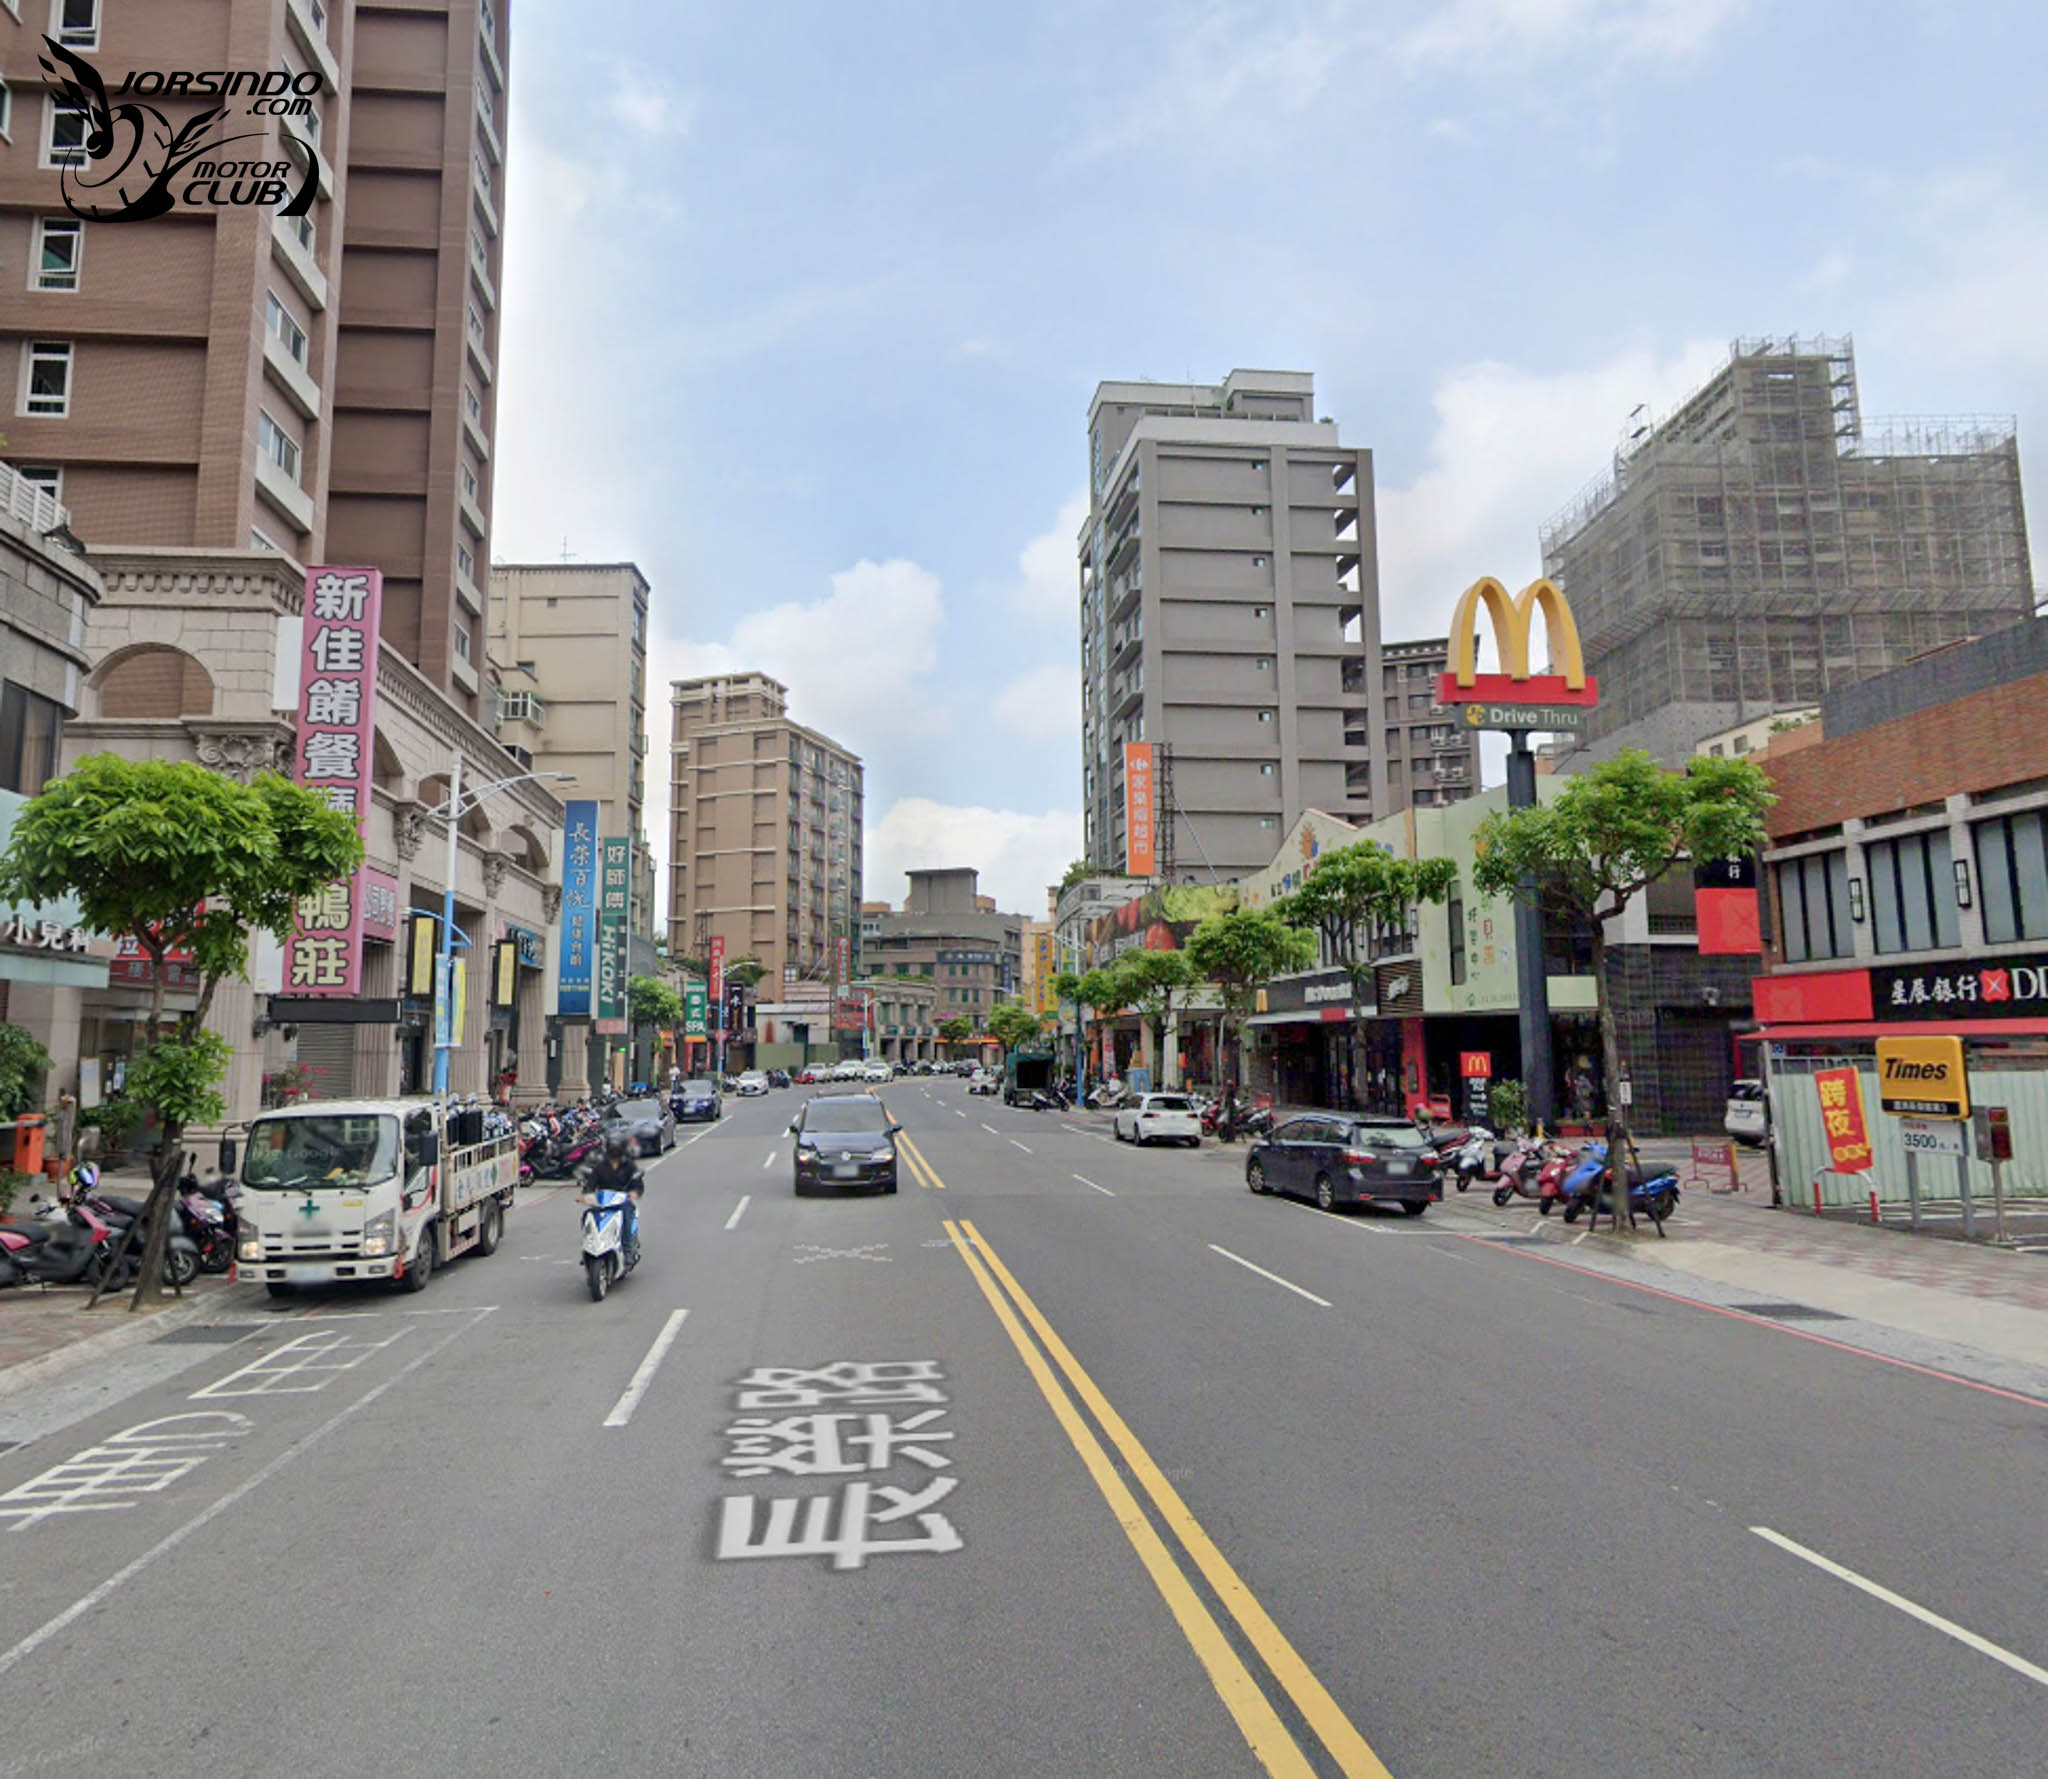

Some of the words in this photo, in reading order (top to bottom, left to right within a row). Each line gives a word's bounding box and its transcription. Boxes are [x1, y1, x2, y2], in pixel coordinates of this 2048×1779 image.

[1490, 708, 1538, 724] Drive
[1539, 709, 1578, 726] Thru
[1885, 1057, 1948, 1080] Times
[1903, 1132, 1937, 1149] 3500
[717, 1360, 964, 1569] 長榮路
